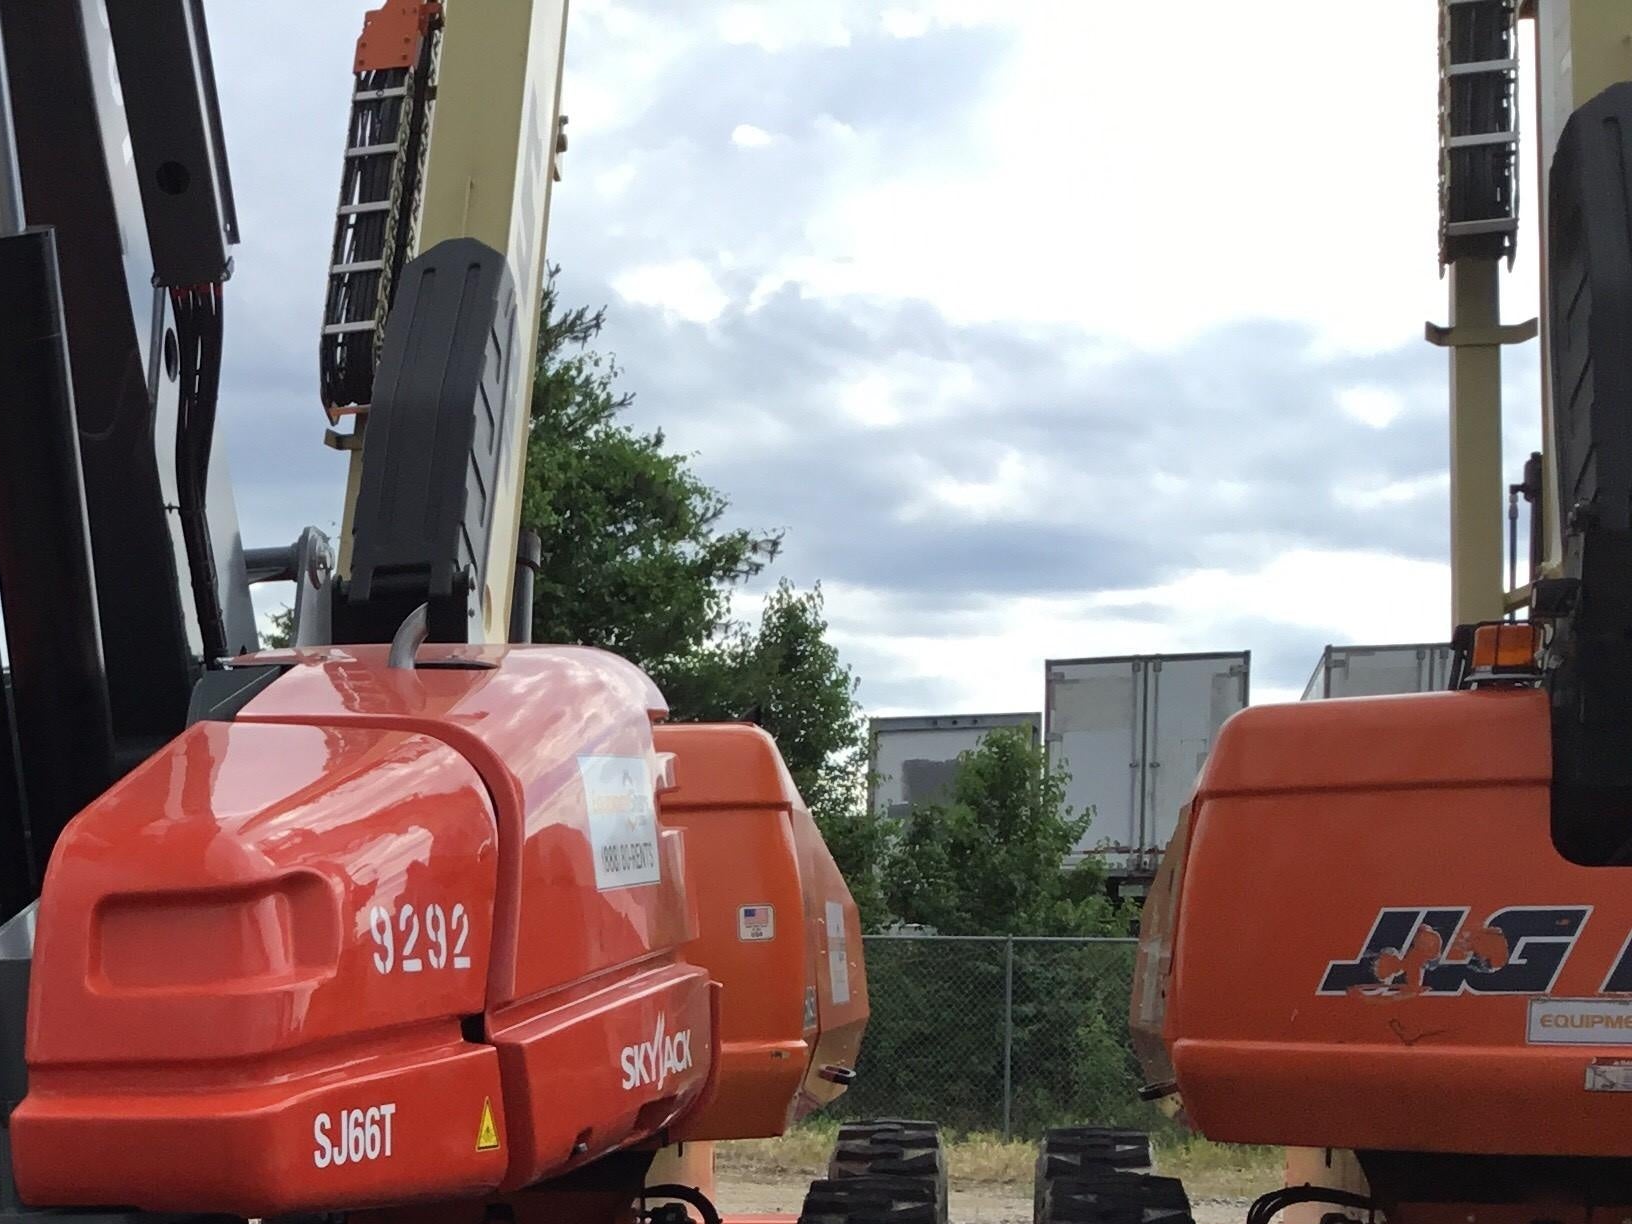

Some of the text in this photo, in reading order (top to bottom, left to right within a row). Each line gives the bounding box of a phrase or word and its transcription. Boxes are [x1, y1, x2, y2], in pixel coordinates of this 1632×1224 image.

[371, 903, 471, 974] 9292
[621, 1010, 693, 1090] SKYJACK
[314, 1103, 396, 1168] SJ66T
